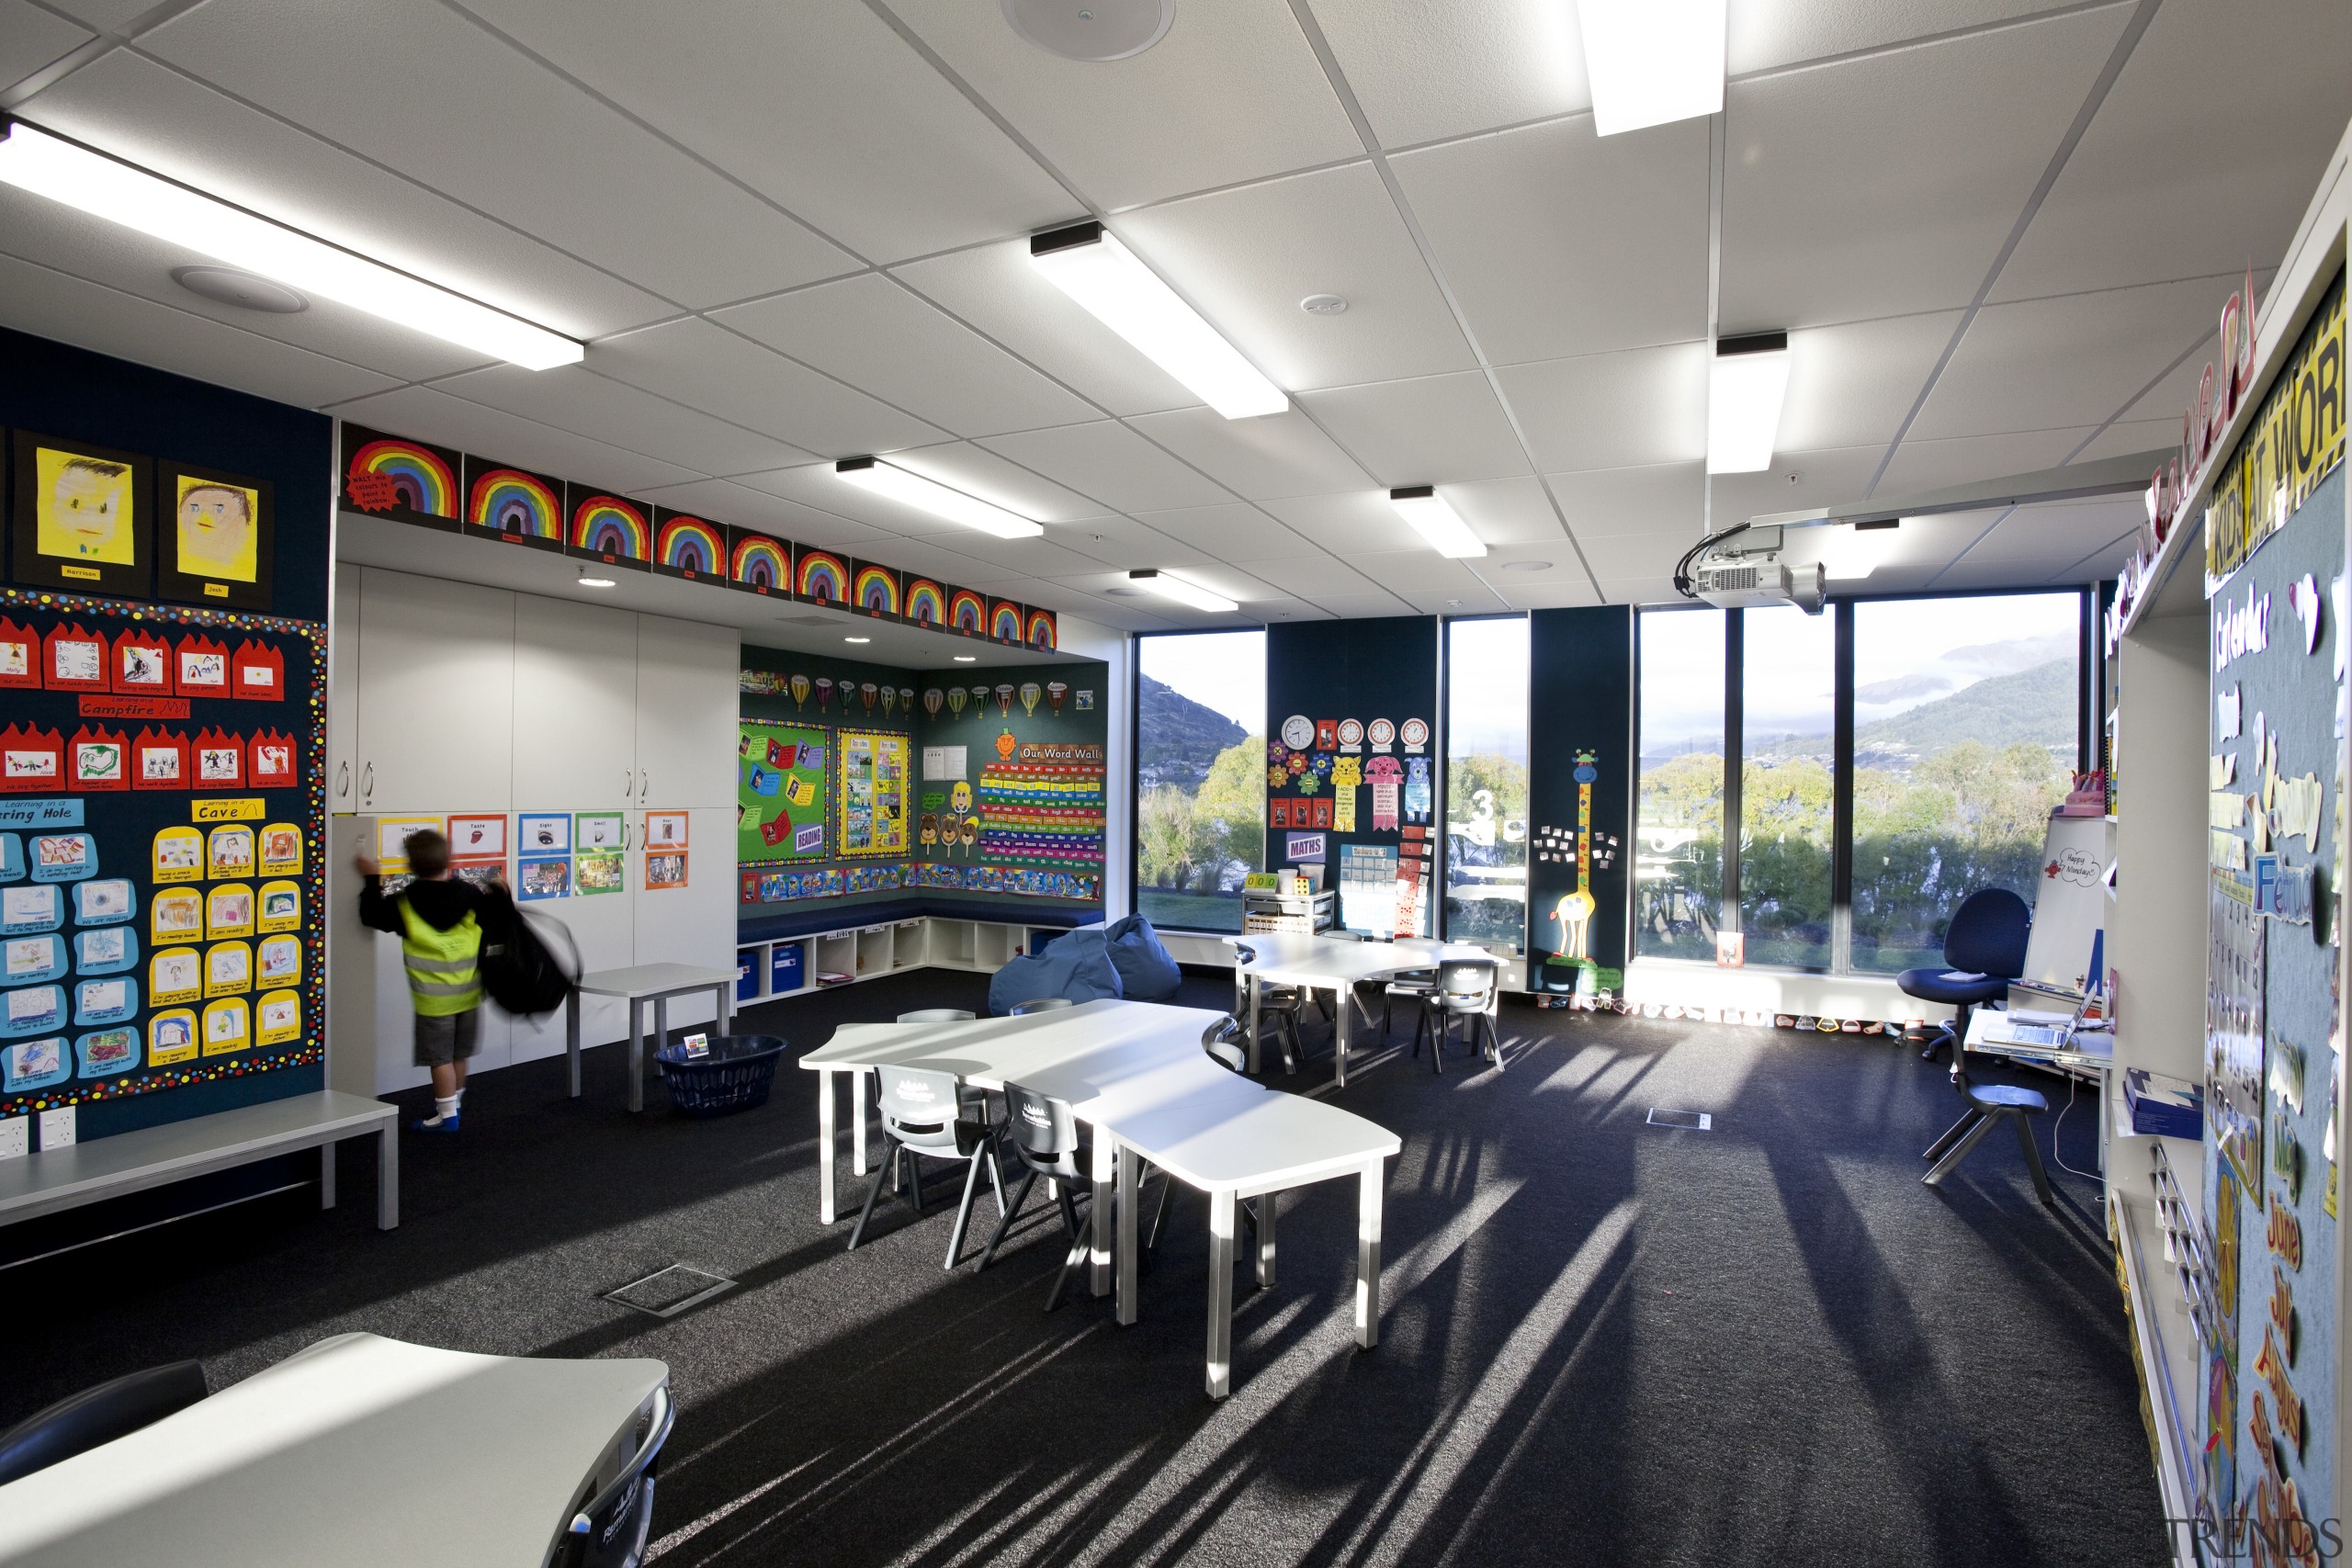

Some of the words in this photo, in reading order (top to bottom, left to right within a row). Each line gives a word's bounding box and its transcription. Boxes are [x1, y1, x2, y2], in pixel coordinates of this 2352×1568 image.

[2214, 488, 2244, 568] KIDS
[2249, 438, 2266, 533] AT
[2273, 318, 2346, 492] WOR
[67, 569, 96, 577] Harrison
[82, 704, 154, 717] Campfire
[1023, 748, 1040, 758] Our
[1044, 749, 1071, 759] Word
[1075, 750, 1099, 759] Wall
[43, 808, 72, 818] Hole
[198, 807, 238, 818] Cave
[798, 829, 821, 849] READING
[1291, 839, 1321, 856] MATHS
[2067, 854, 2085, 865] Happy
[2066, 865, 2090, 878] Monday
[2267, 1196, 2298, 1264] June
[2256, 1326, 2300, 1443] Augus
